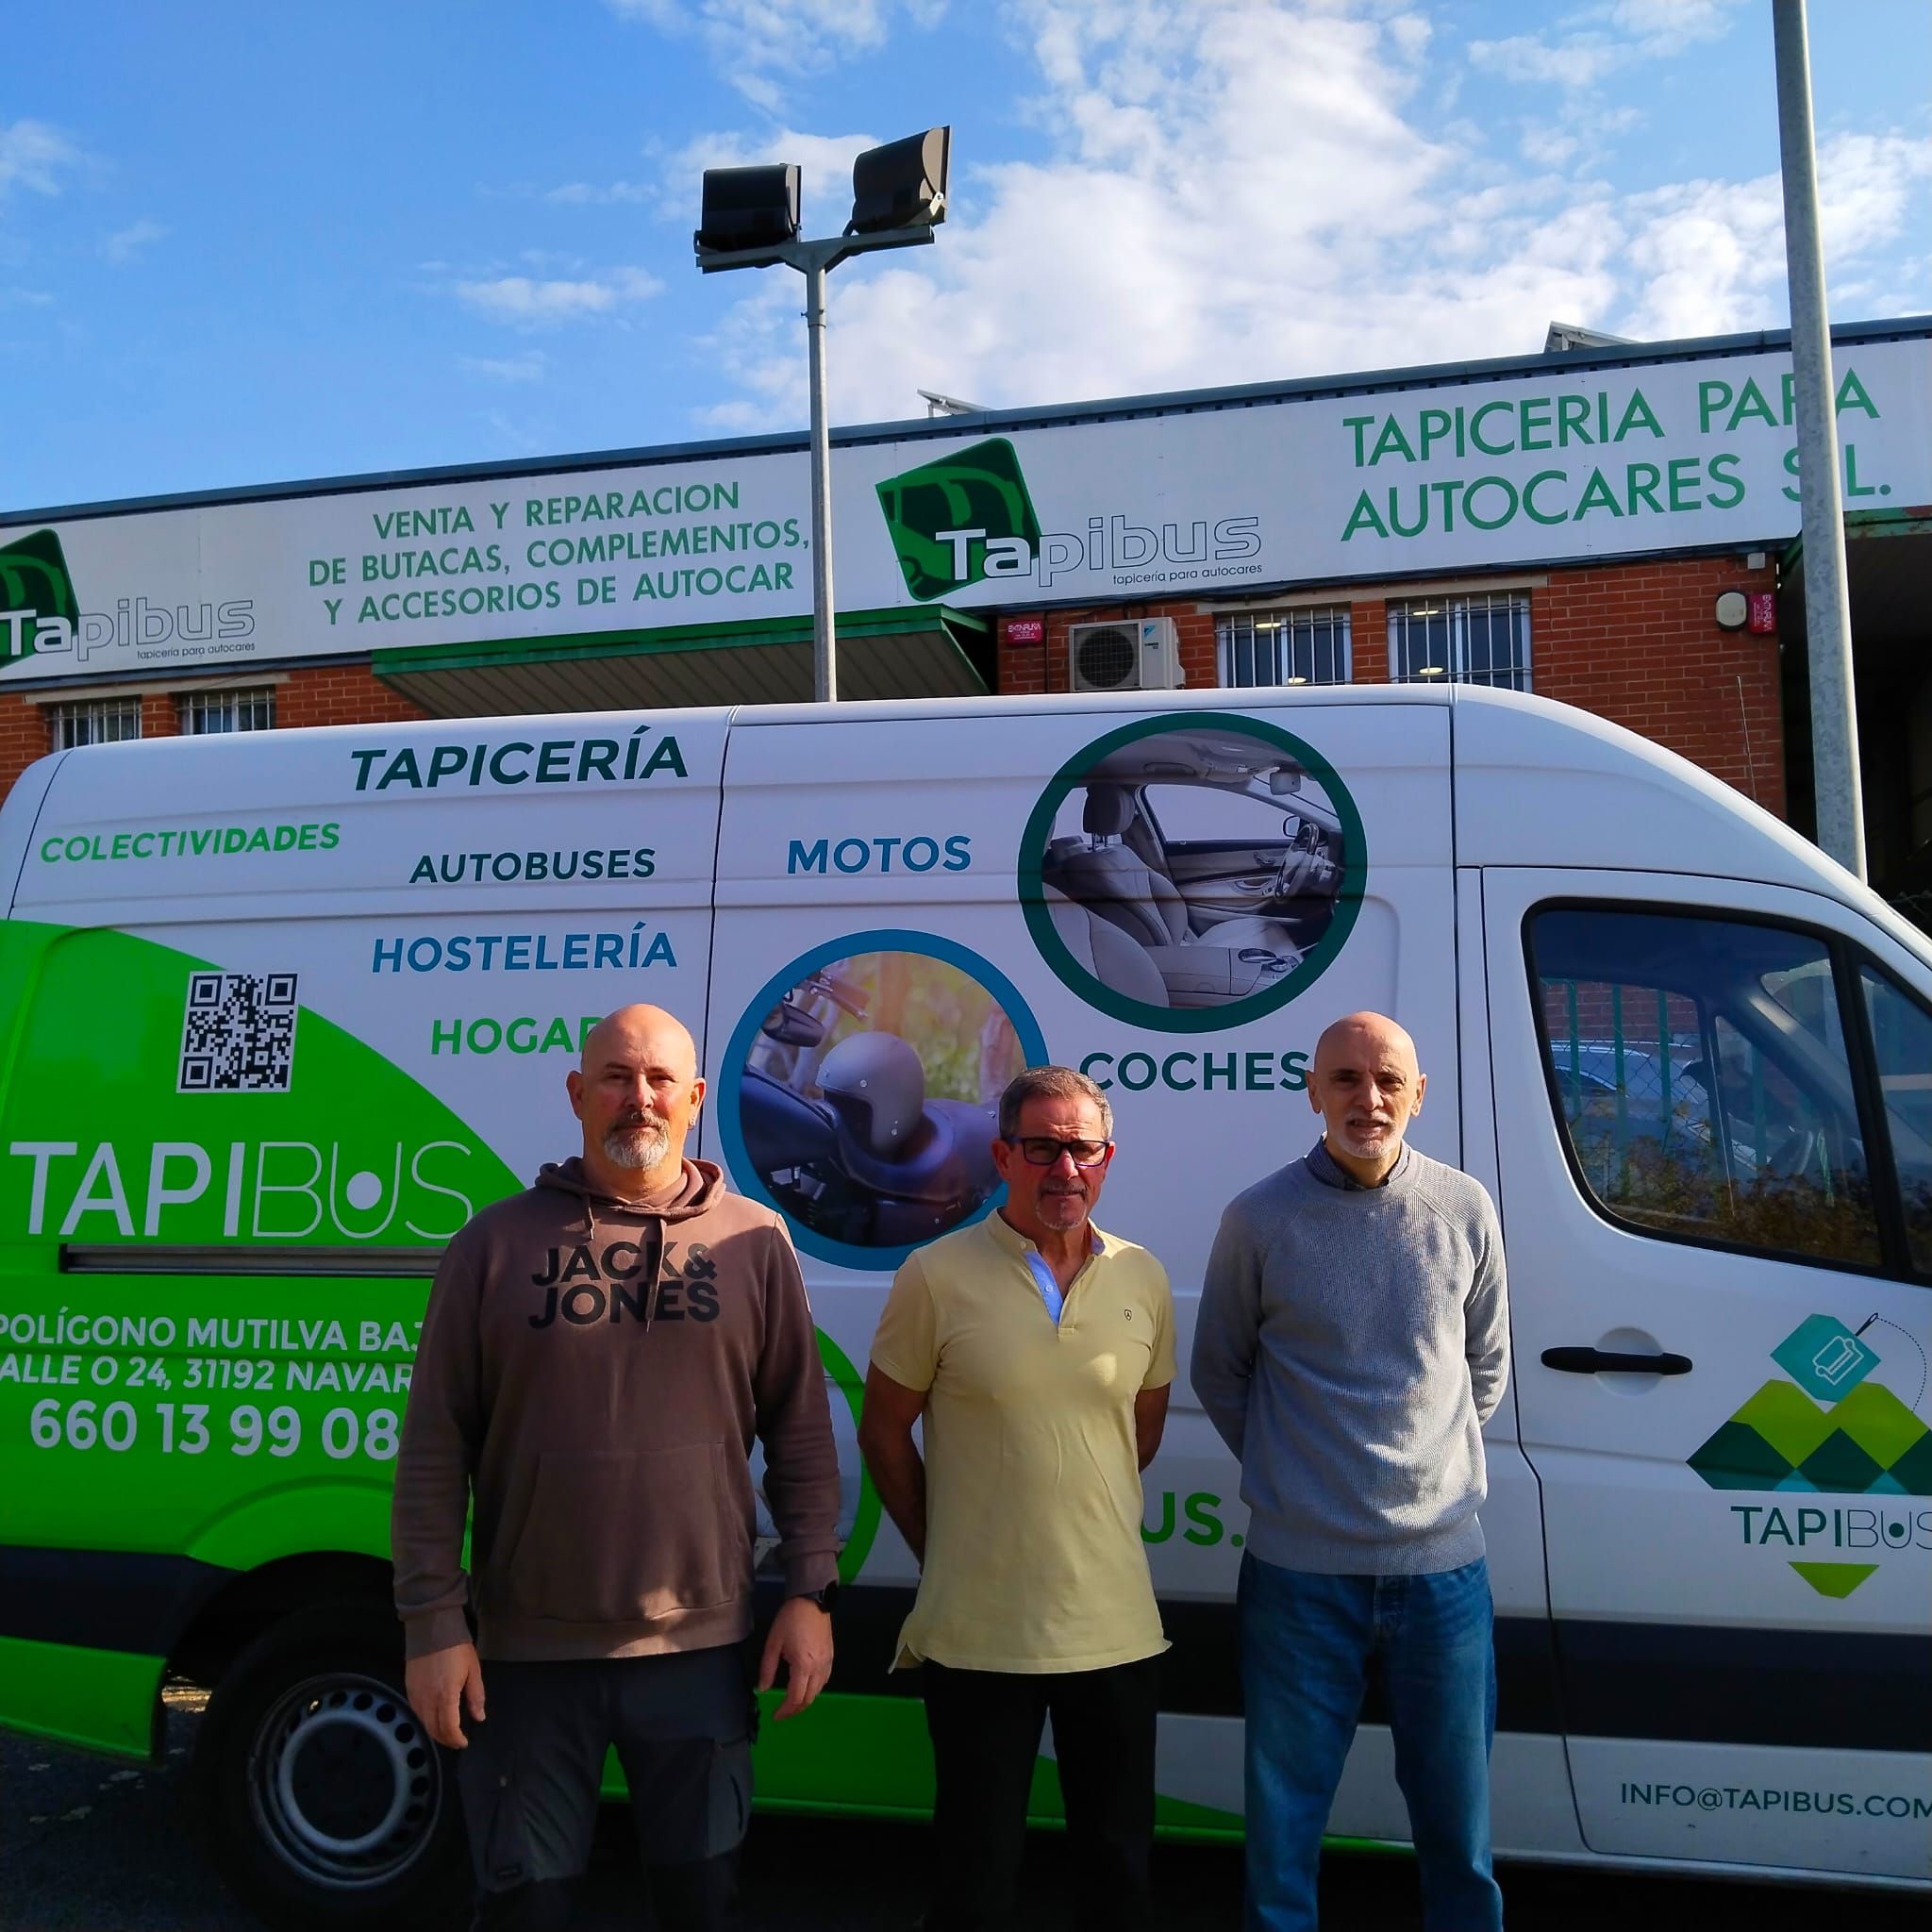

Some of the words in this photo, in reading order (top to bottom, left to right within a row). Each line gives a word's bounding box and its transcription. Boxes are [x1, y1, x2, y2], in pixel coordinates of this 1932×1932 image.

[1342, 387, 1665, 468] TAPICERIA
[373, 506, 475, 540] VENTA
[490, 502, 510, 529] Y
[525, 481, 740, 527] REPARACION
[1340, 453, 1746, 542] AUTOCARES
[308, 558, 346, 587] DE
[361, 544, 511, 581] BUTACAS,
[526, 518, 810, 568] COMPLEMENTOS,
[936, 514, 1262, 588] Tapibus
[1112, 570, 1166, 586] tapicería
[1169, 569, 1198, 582] para
[1201, 564, 1263, 578] autocares
[324, 598, 343, 625] Y
[358, 581, 561, 624] ACCESORIOS
[577, 576, 617, 606] DE
[633, 562, 794, 602] AUTOCAR
[0, 597, 256, 662] Tapibus
[182, 646, 206, 658] para
[208, 641, 256, 656] autocares
[350, 724, 690, 791] TAPICERÍA
[40, 823, 341, 863] COLECTIVIDADES
[409, 848, 656, 883] AUTOBUSES
[787, 835, 972, 874] MOTOS
[373, 922, 678, 974] HOSTELERÍA
[1079, 1051, 1310, 1091] COCHES
[9, 1141, 473, 1240] TAPIBUS
[528, 1280, 720, 1330] JONES
[187, 1318, 348, 1352] MUTILVA
[91, 1356, 119, 1386] O
[125, 1357, 172, 1391] 24,
[183, 1357, 275, 1391] 31192
[30, 1398, 138, 1452] 660
[156, 1403, 210, 1454] 13
[229, 1405, 302, 1457] 99
[321, 1407, 400, 1460] 08
[1621, 1782, 1932, 1820] INFO@TAPIBUS.COM
